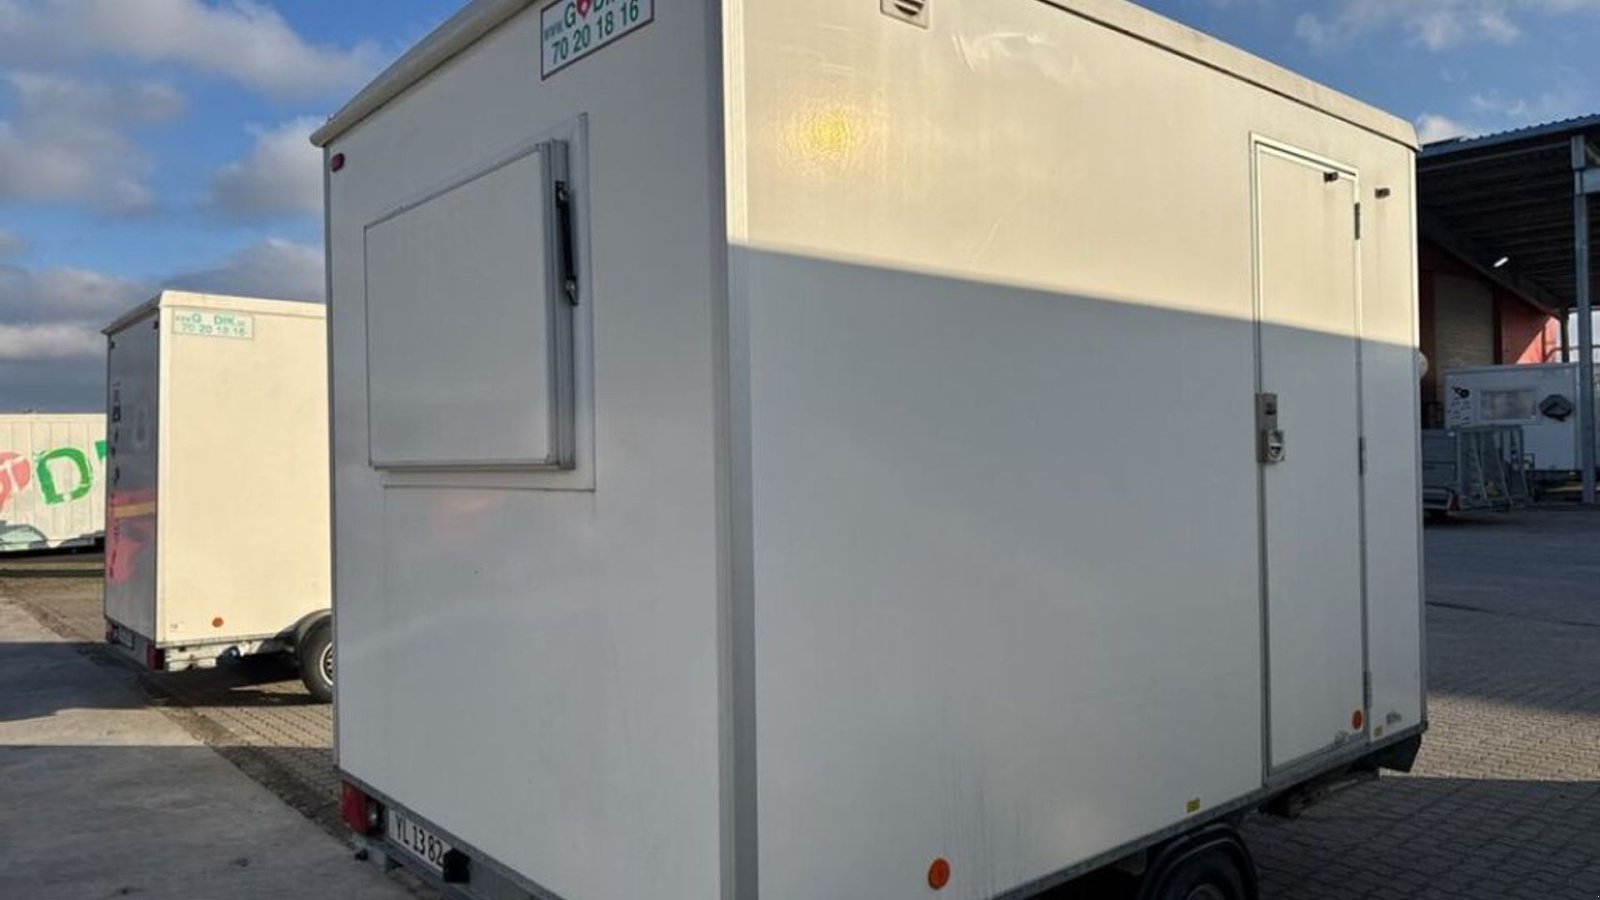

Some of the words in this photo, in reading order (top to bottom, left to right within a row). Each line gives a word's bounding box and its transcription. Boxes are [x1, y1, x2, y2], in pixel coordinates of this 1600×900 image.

[552, 37, 568, 64] 70
[573, 24, 590, 52] 20
[597, 11, 614, 39] 18
[621, 0, 639, 25] 16
[396, 813, 409, 845] YL
[413, 825, 426, 855] 13
[428, 835, 444, 867] 82
